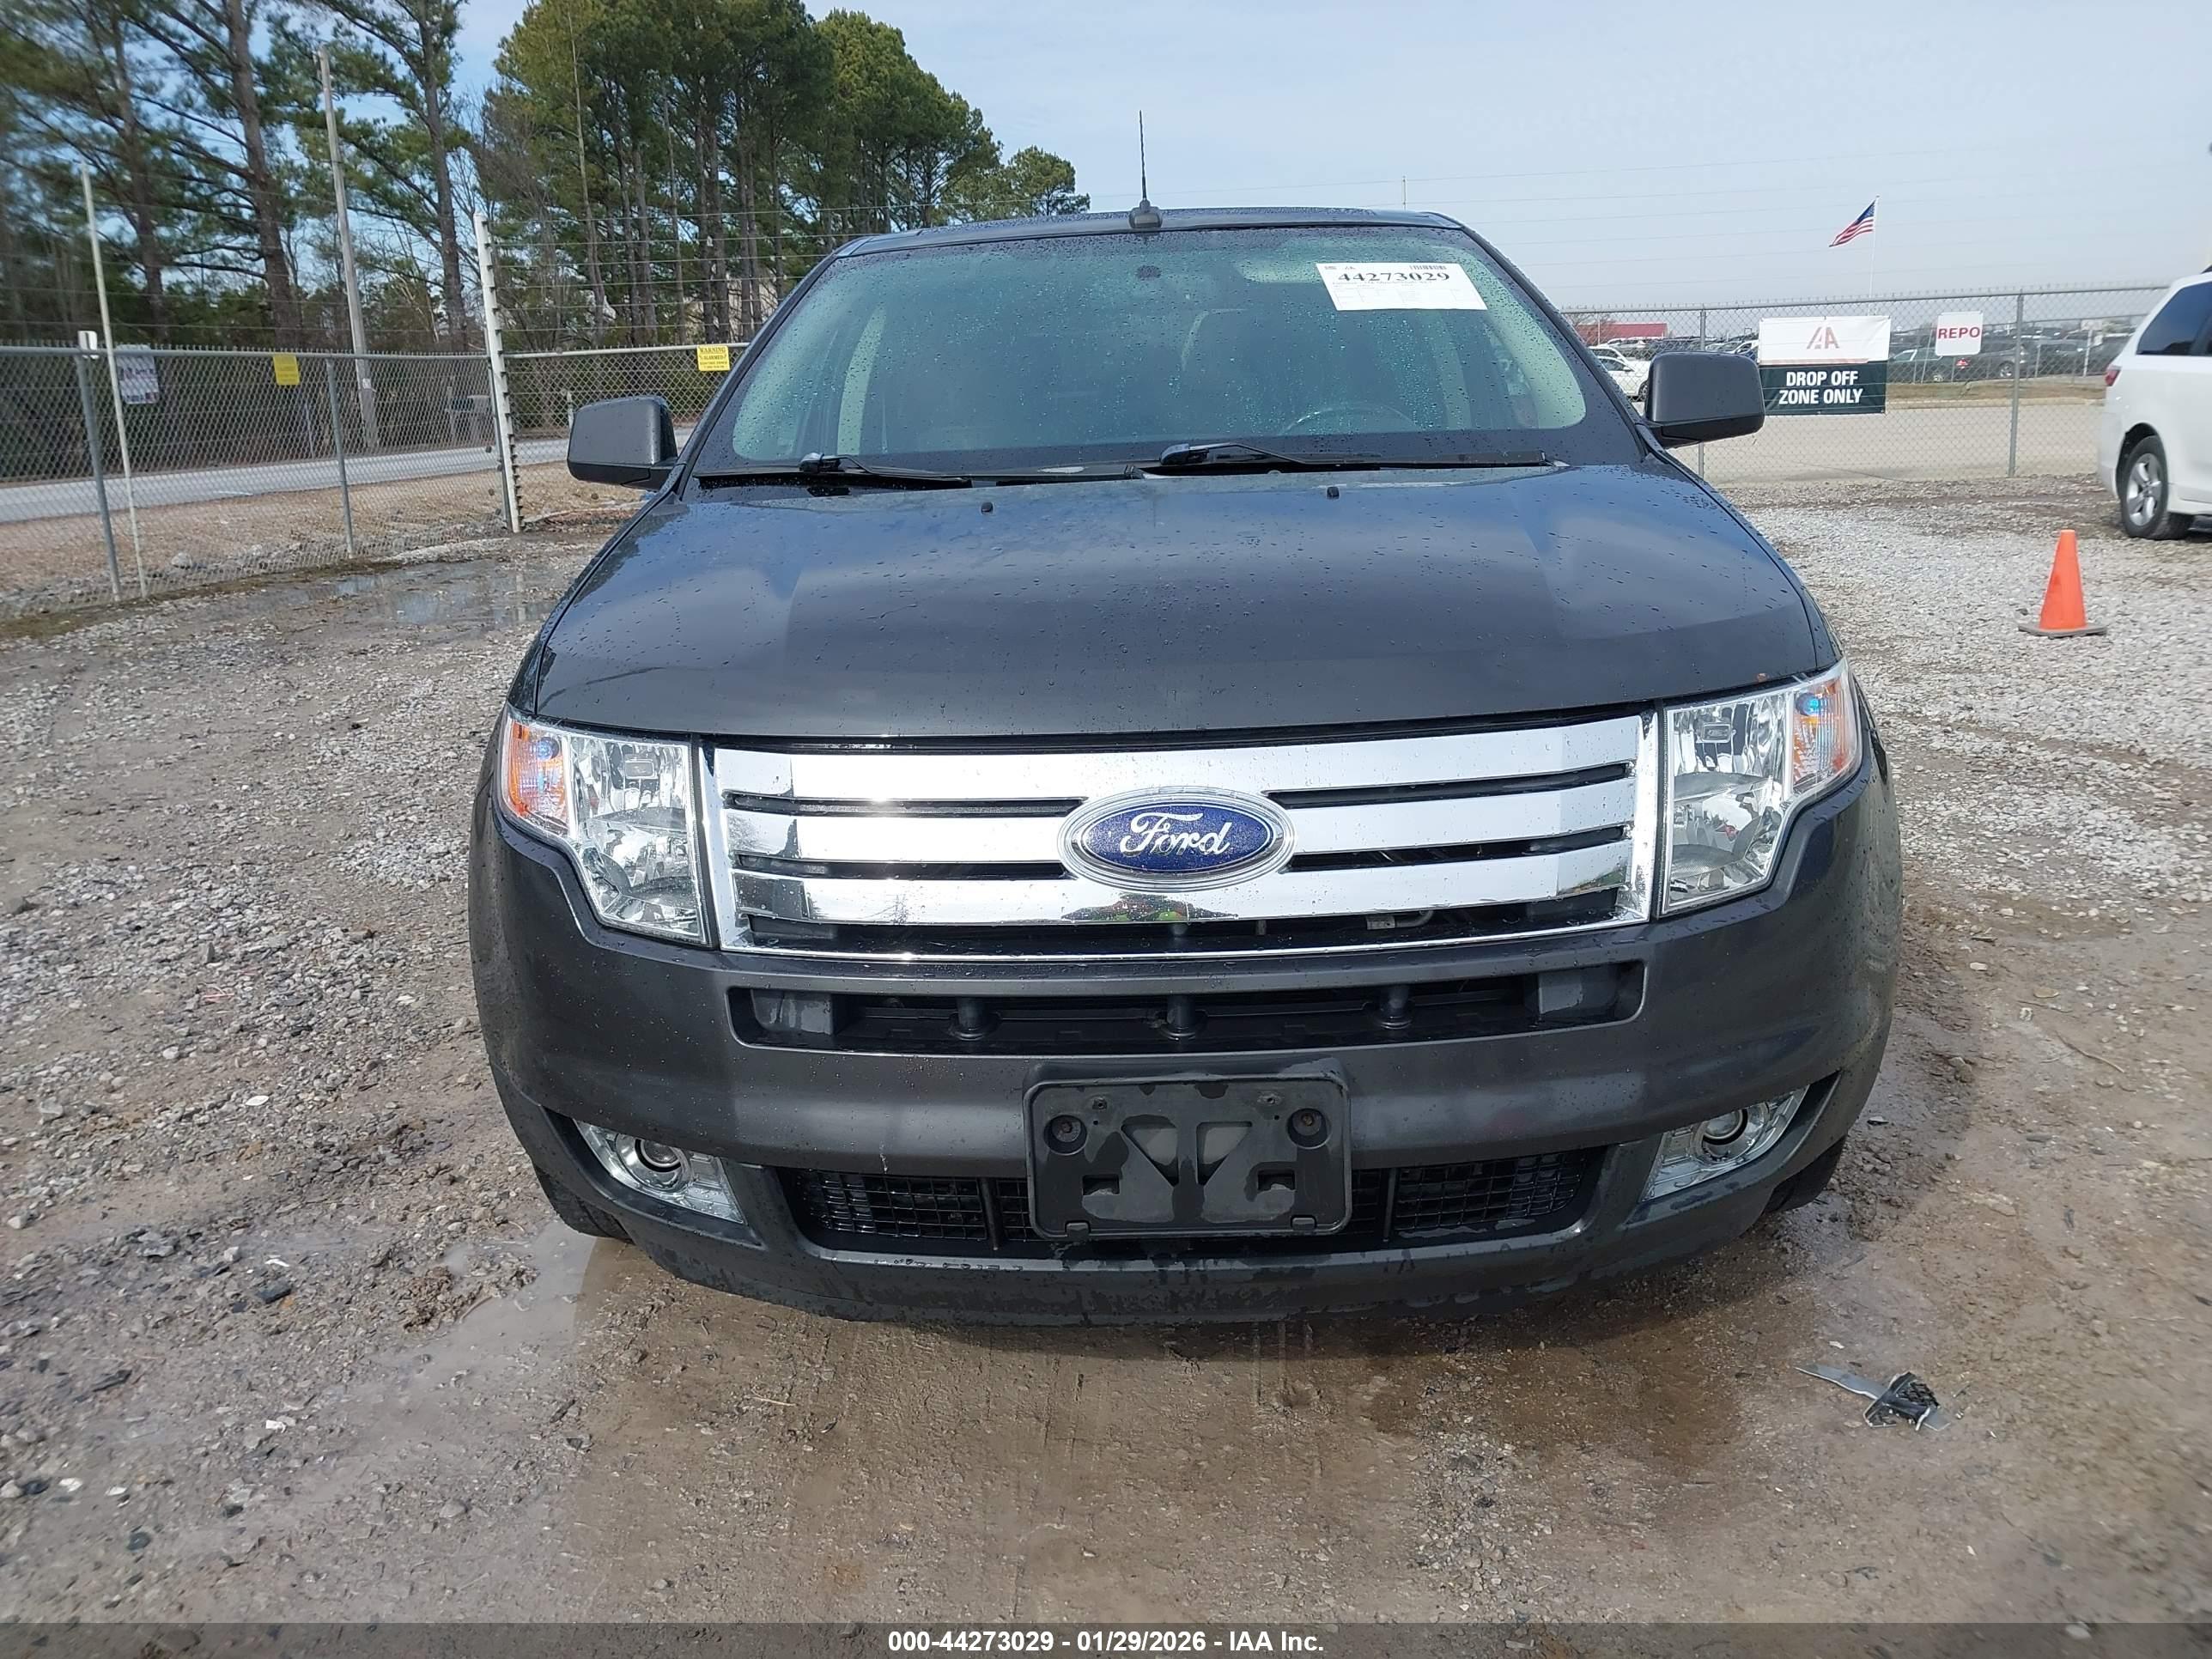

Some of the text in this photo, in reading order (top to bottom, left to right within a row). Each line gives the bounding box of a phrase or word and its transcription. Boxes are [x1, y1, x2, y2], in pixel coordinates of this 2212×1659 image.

[1338, 272, 1450, 282] 44273029
[1937, 326, 1980, 339] REPO
[1786, 370, 1859, 386] DROP OFF
[1778, 388, 1863, 404] ZONE ONLY
[1120, 812, 1233, 857] Ford
